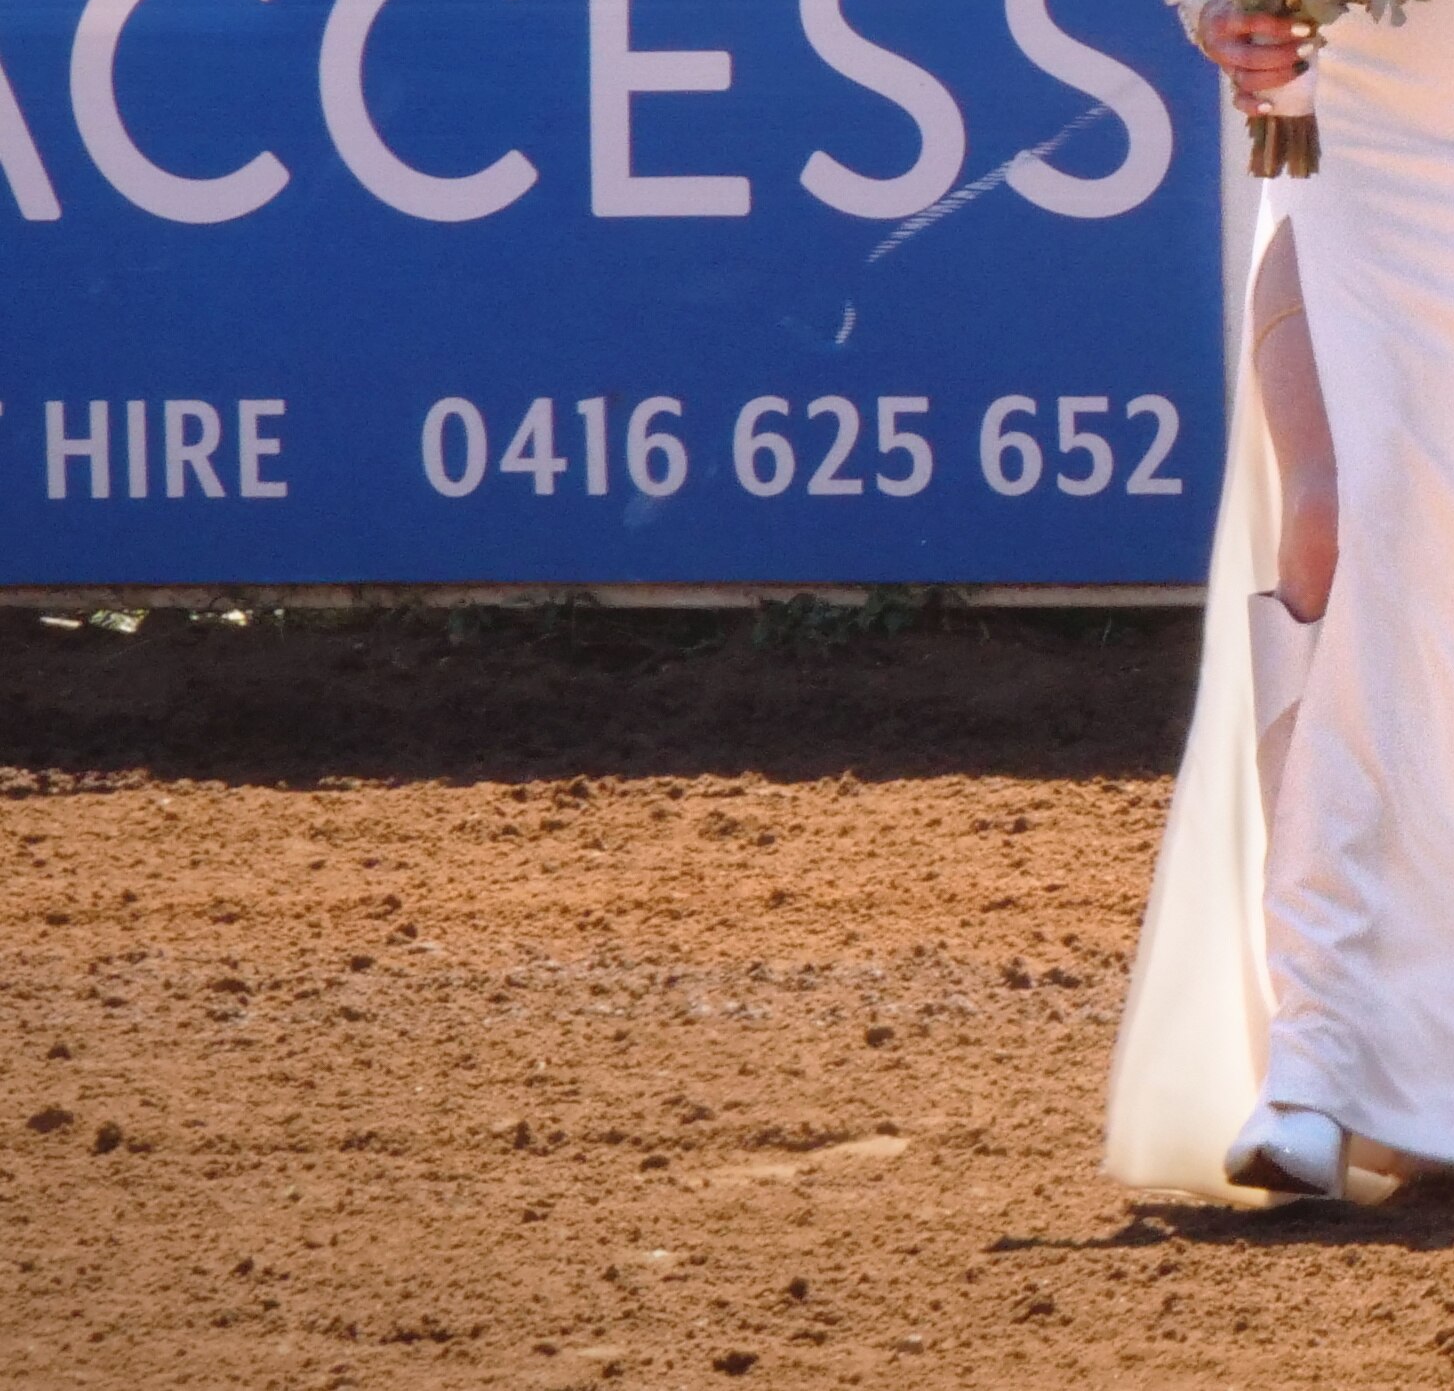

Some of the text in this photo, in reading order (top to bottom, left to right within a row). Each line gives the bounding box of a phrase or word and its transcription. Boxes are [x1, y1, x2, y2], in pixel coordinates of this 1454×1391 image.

[45, 394, 1183, 499] HIRE 0416 625 652
